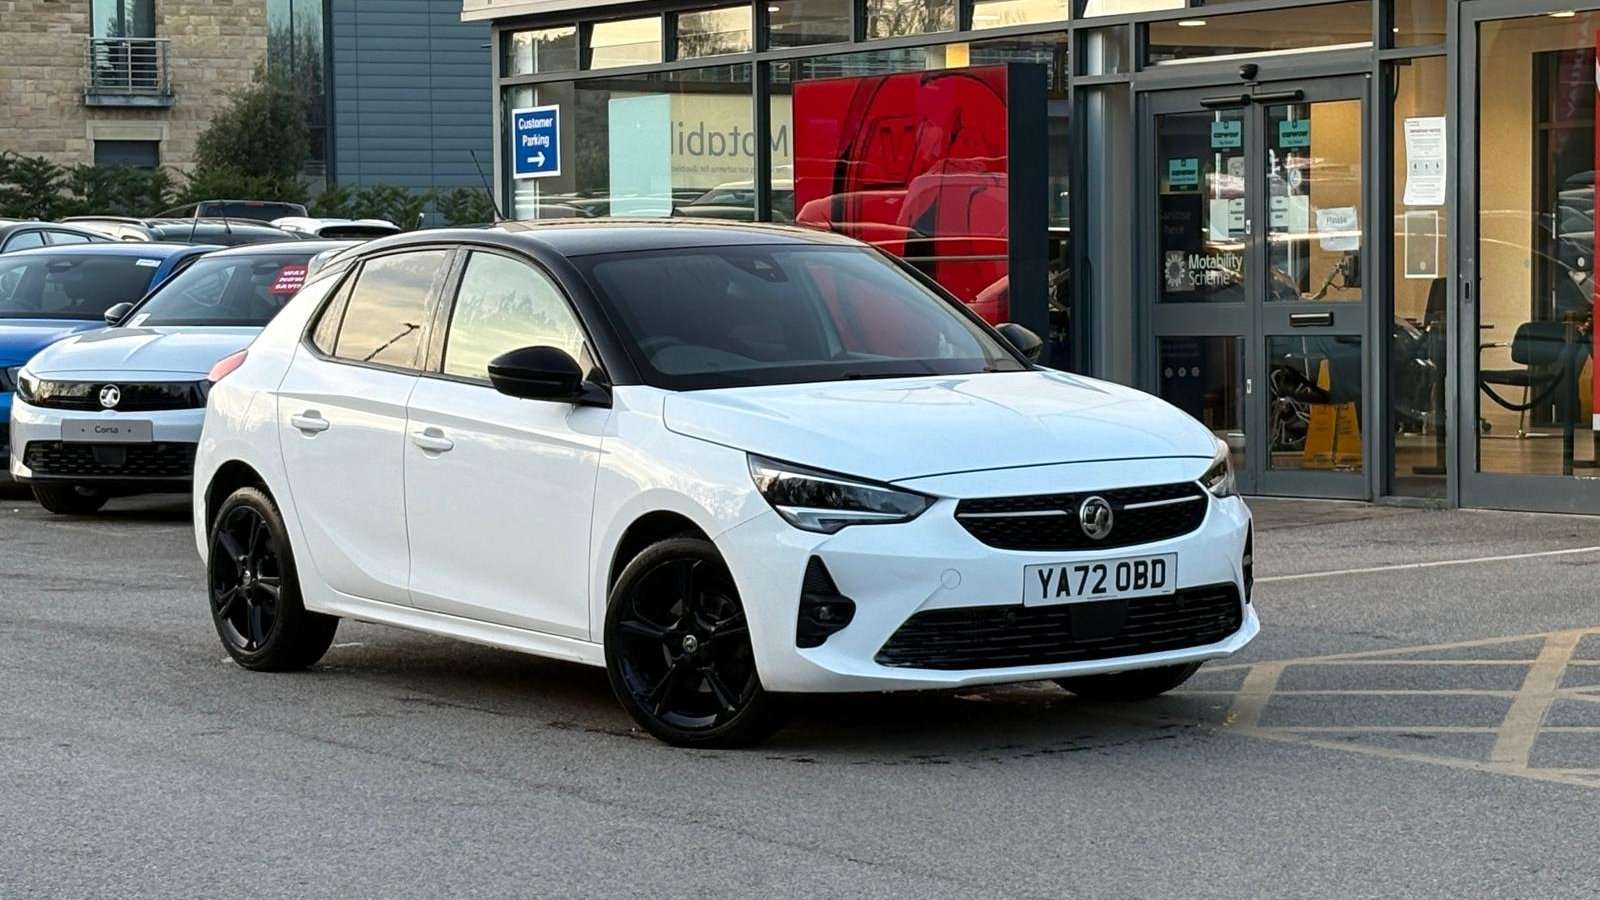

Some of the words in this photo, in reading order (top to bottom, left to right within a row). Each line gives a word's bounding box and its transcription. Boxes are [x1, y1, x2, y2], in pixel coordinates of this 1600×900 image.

[518, 117, 553, 130] Customer
[522, 134, 549, 148] Parking
[1188, 252, 1243, 272] Motability
[1189, 270, 1230, 286] Scheme
[94, 424, 119, 434] Corsa
[1038, 564, 1107, 599] YA72
[1116, 559, 1166, 592] OBD
